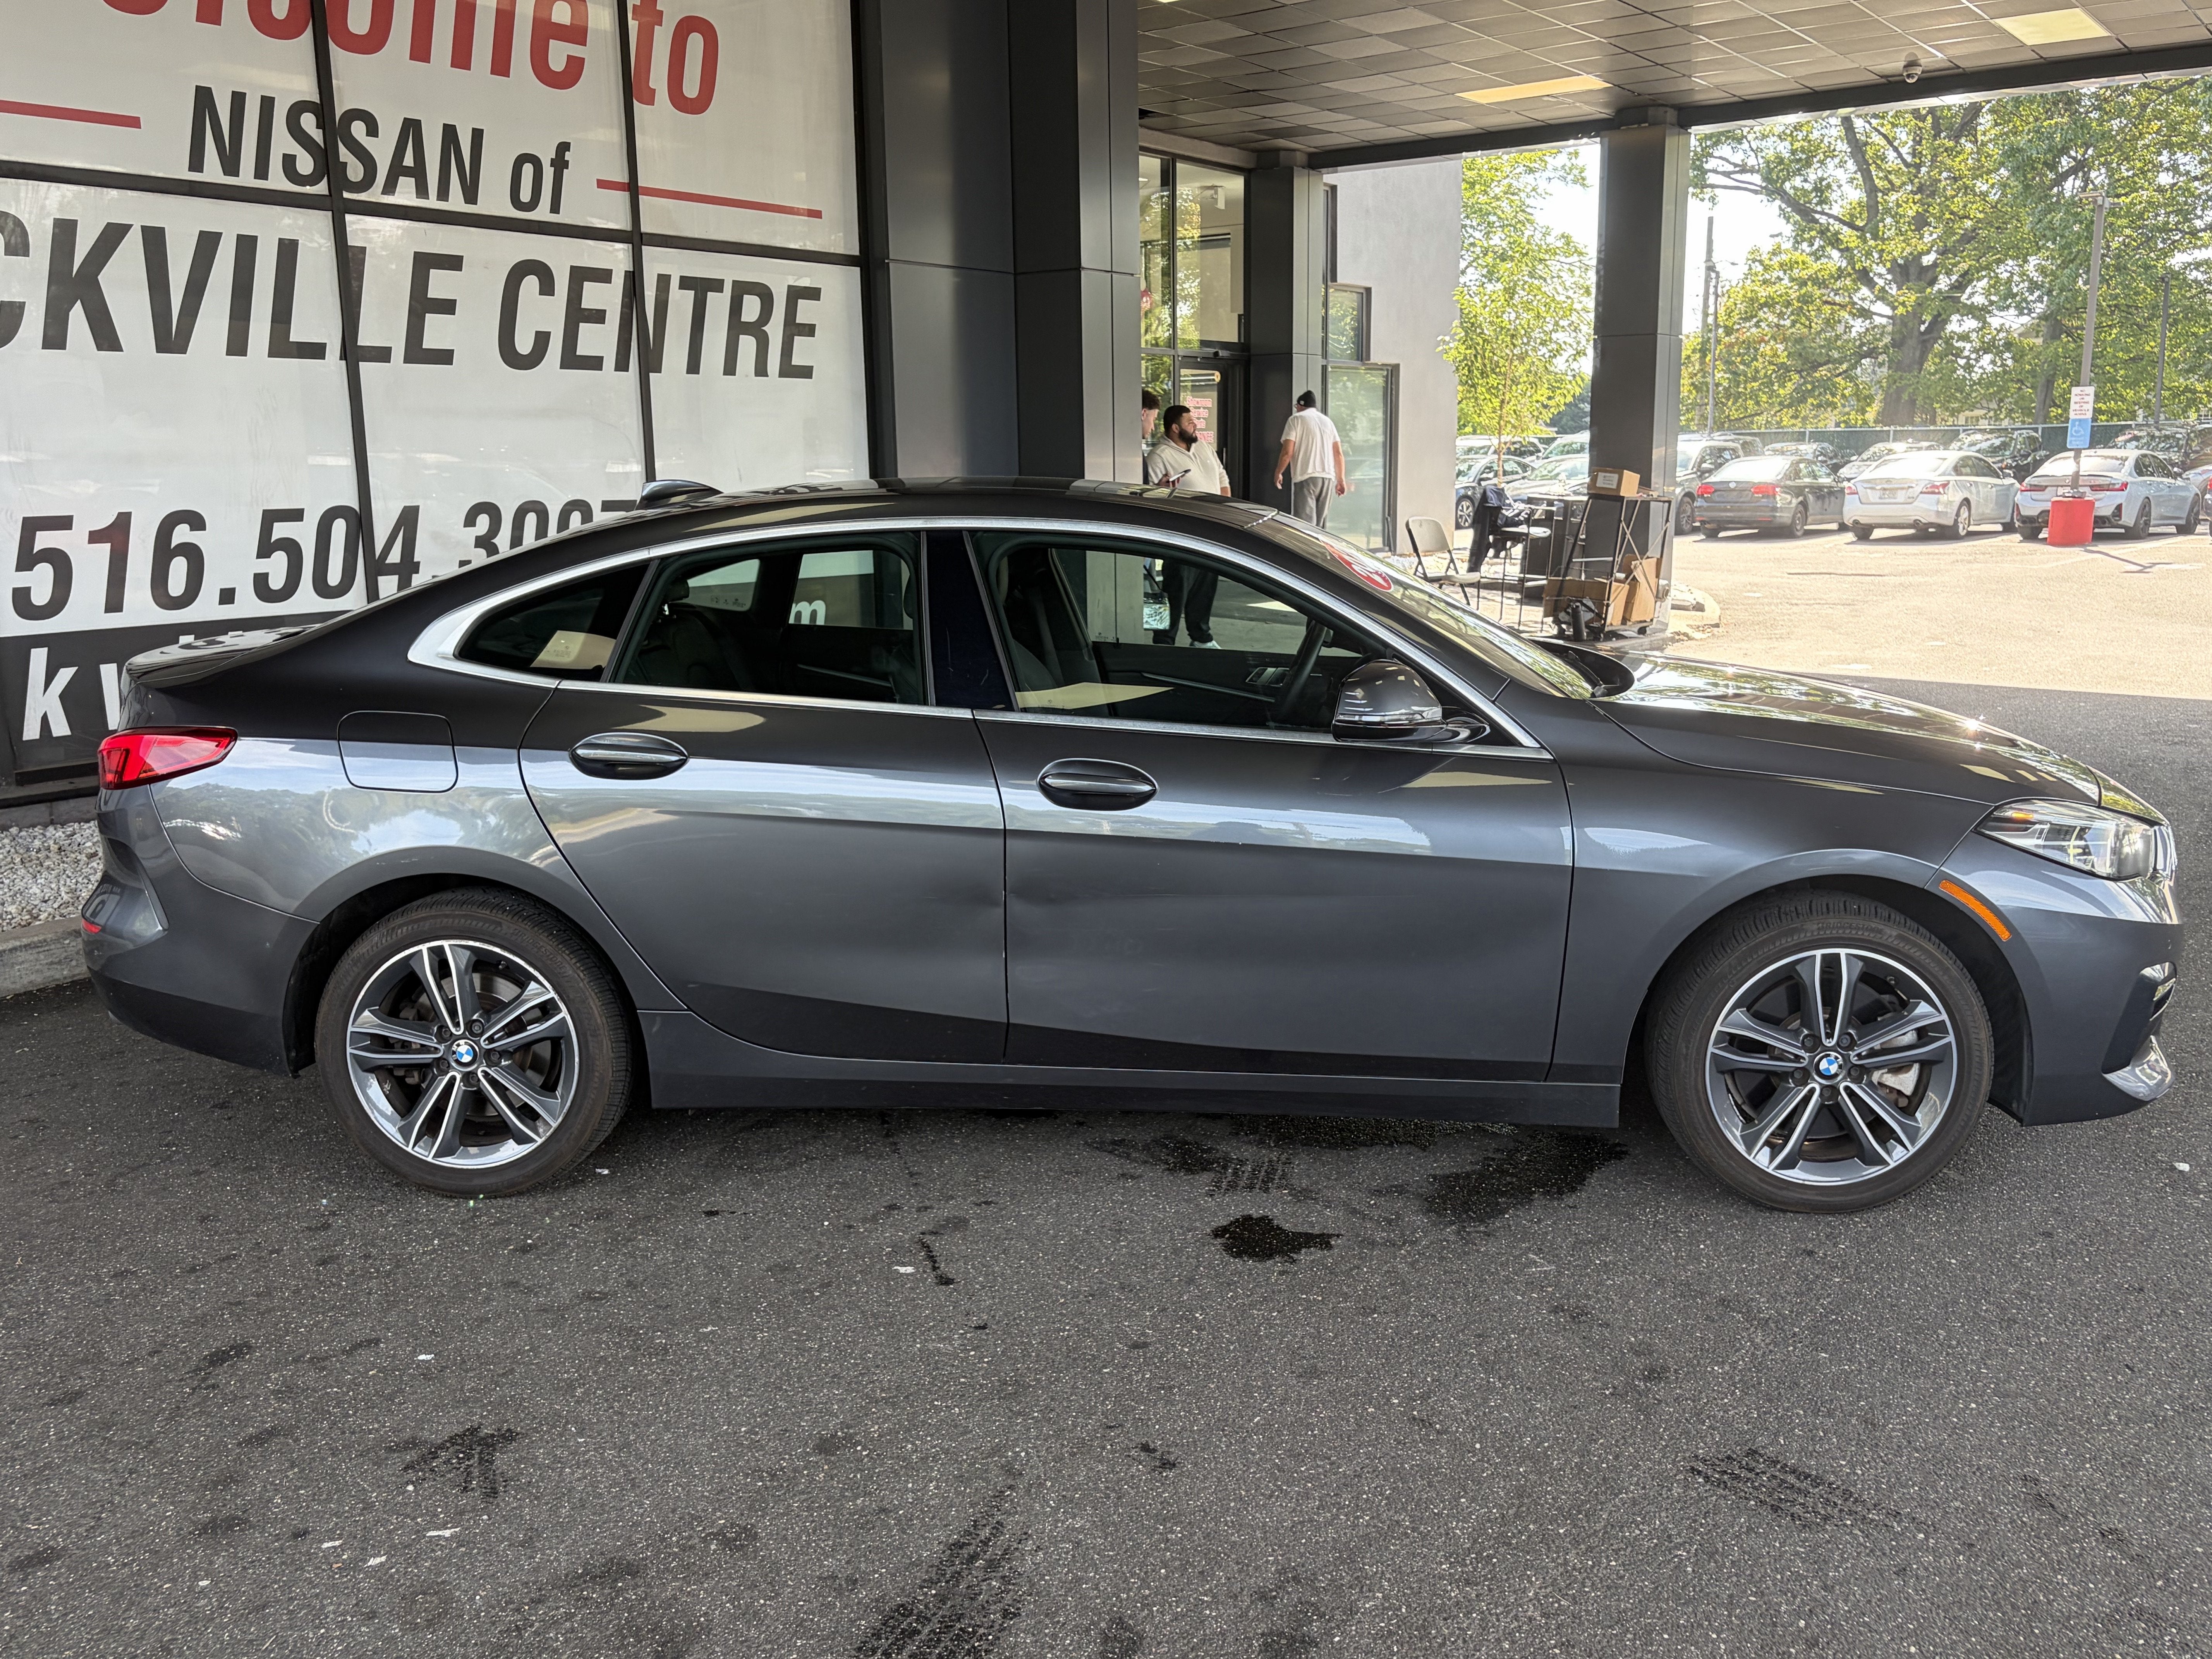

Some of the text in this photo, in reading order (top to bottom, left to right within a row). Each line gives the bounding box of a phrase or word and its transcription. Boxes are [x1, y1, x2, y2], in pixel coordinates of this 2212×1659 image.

[632, 0, 719, 115] to
[188, 85, 571, 215] NISSAN of
[498, 259, 821, 380] CENTRE
